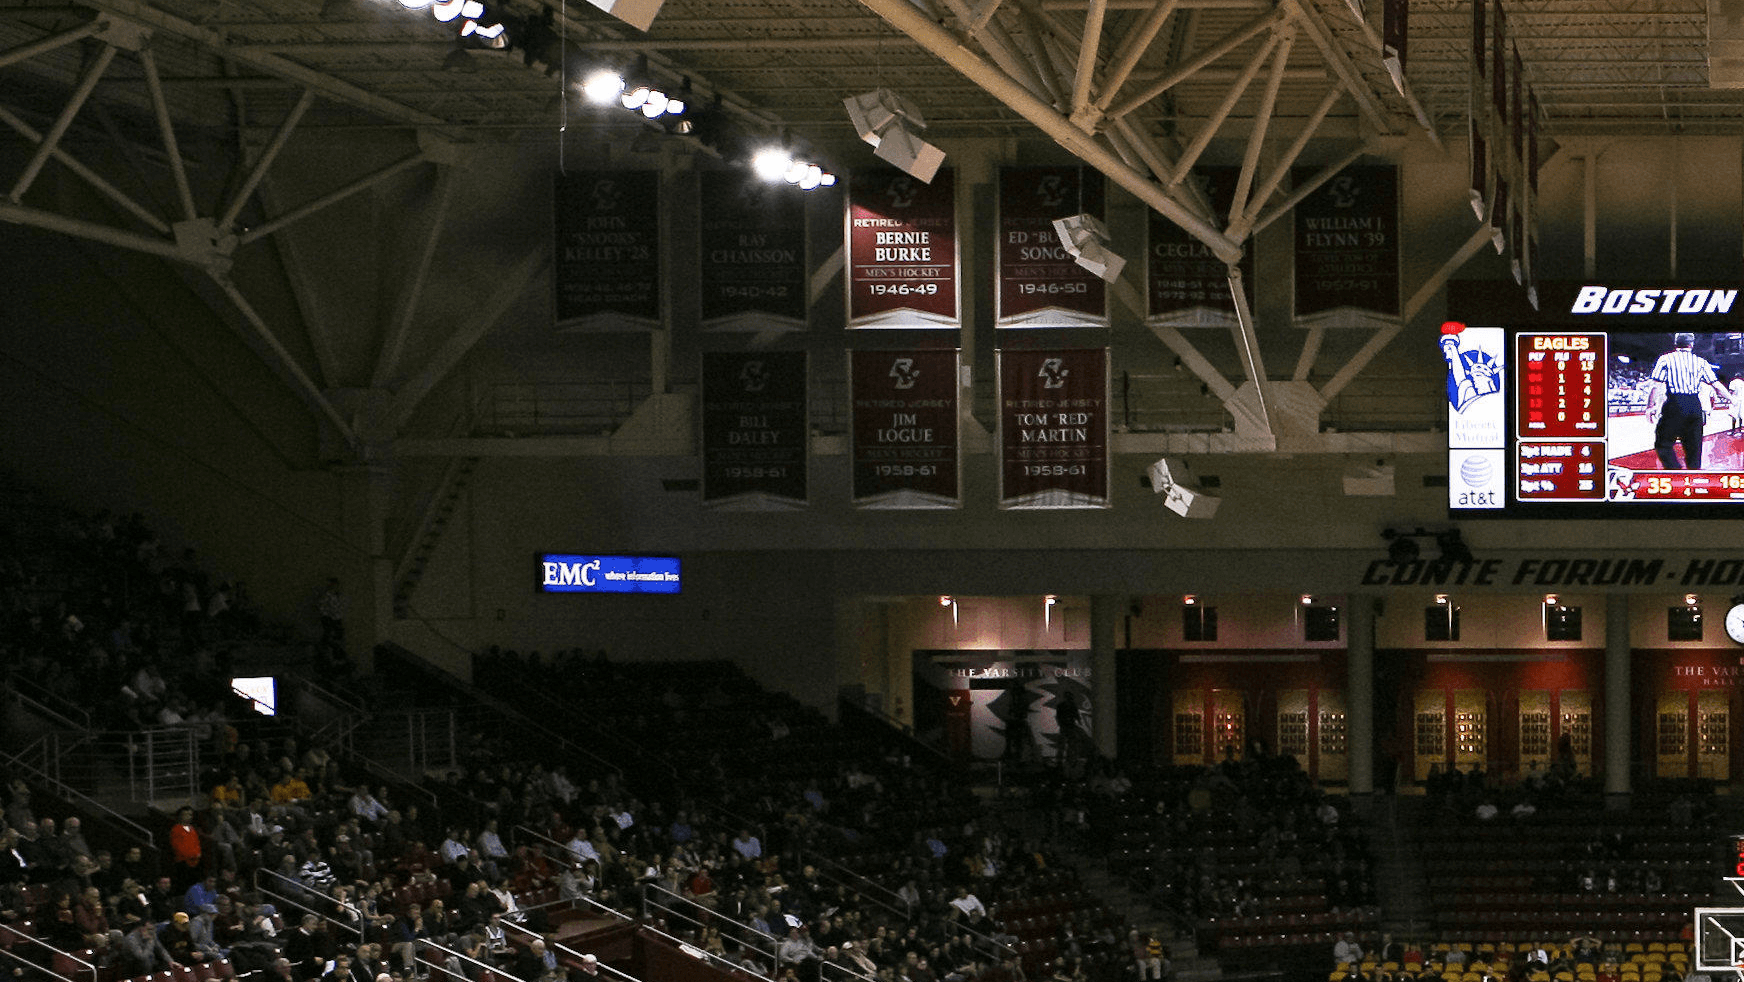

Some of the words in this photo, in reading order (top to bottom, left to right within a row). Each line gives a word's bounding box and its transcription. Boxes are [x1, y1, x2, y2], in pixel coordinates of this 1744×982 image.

[1306, 217, 1373, 230] WILLIAM
[876, 232, 929, 244] BERNIE
[1009, 232, 1027, 243] ED
[1307, 233, 1359, 246] FLYNN
[875, 247, 931, 261] BURKE
[865, 268, 897, 277] MEN'S
[899, 268, 941, 277] HOCKEY
[870, 284, 938, 294] 1946-49
[1019, 284, 1087, 294] 1946-50
[1571, 286, 1738, 314] BOSTON
[1534, 337, 1589, 350] EAGLES
[1581, 362, 1594, 371] 15
[1558, 374, 1565, 383] 1
[1584, 374, 1591, 383] 2
[1558, 386, 1565, 396] 1
[1584, 386, 1591, 396] 4
[1558, 399, 1566, 408] 2
[1584, 399, 1591, 408] 7
[893, 413, 917, 428] JIM
[1017, 413, 1047, 426] TOM
[1558, 412, 1566, 422] 0
[1582, 412, 1591, 422] 0
[877, 428, 933, 443] LOGUE
[1021, 428, 1087, 442] MARTIN
[724, 466, 787, 478] 1958-61
[875, 465, 937, 476] 1958-61
[1024, 465, 1086, 476] 1958-61
[1648, 478, 1672, 494] 35
[1459, 490, 1495, 505] at&t
[1362, 559, 1505, 587] CONTE
[1514, 559, 1667, 587] FORUM
[1674, 666, 1704, 676] THE
